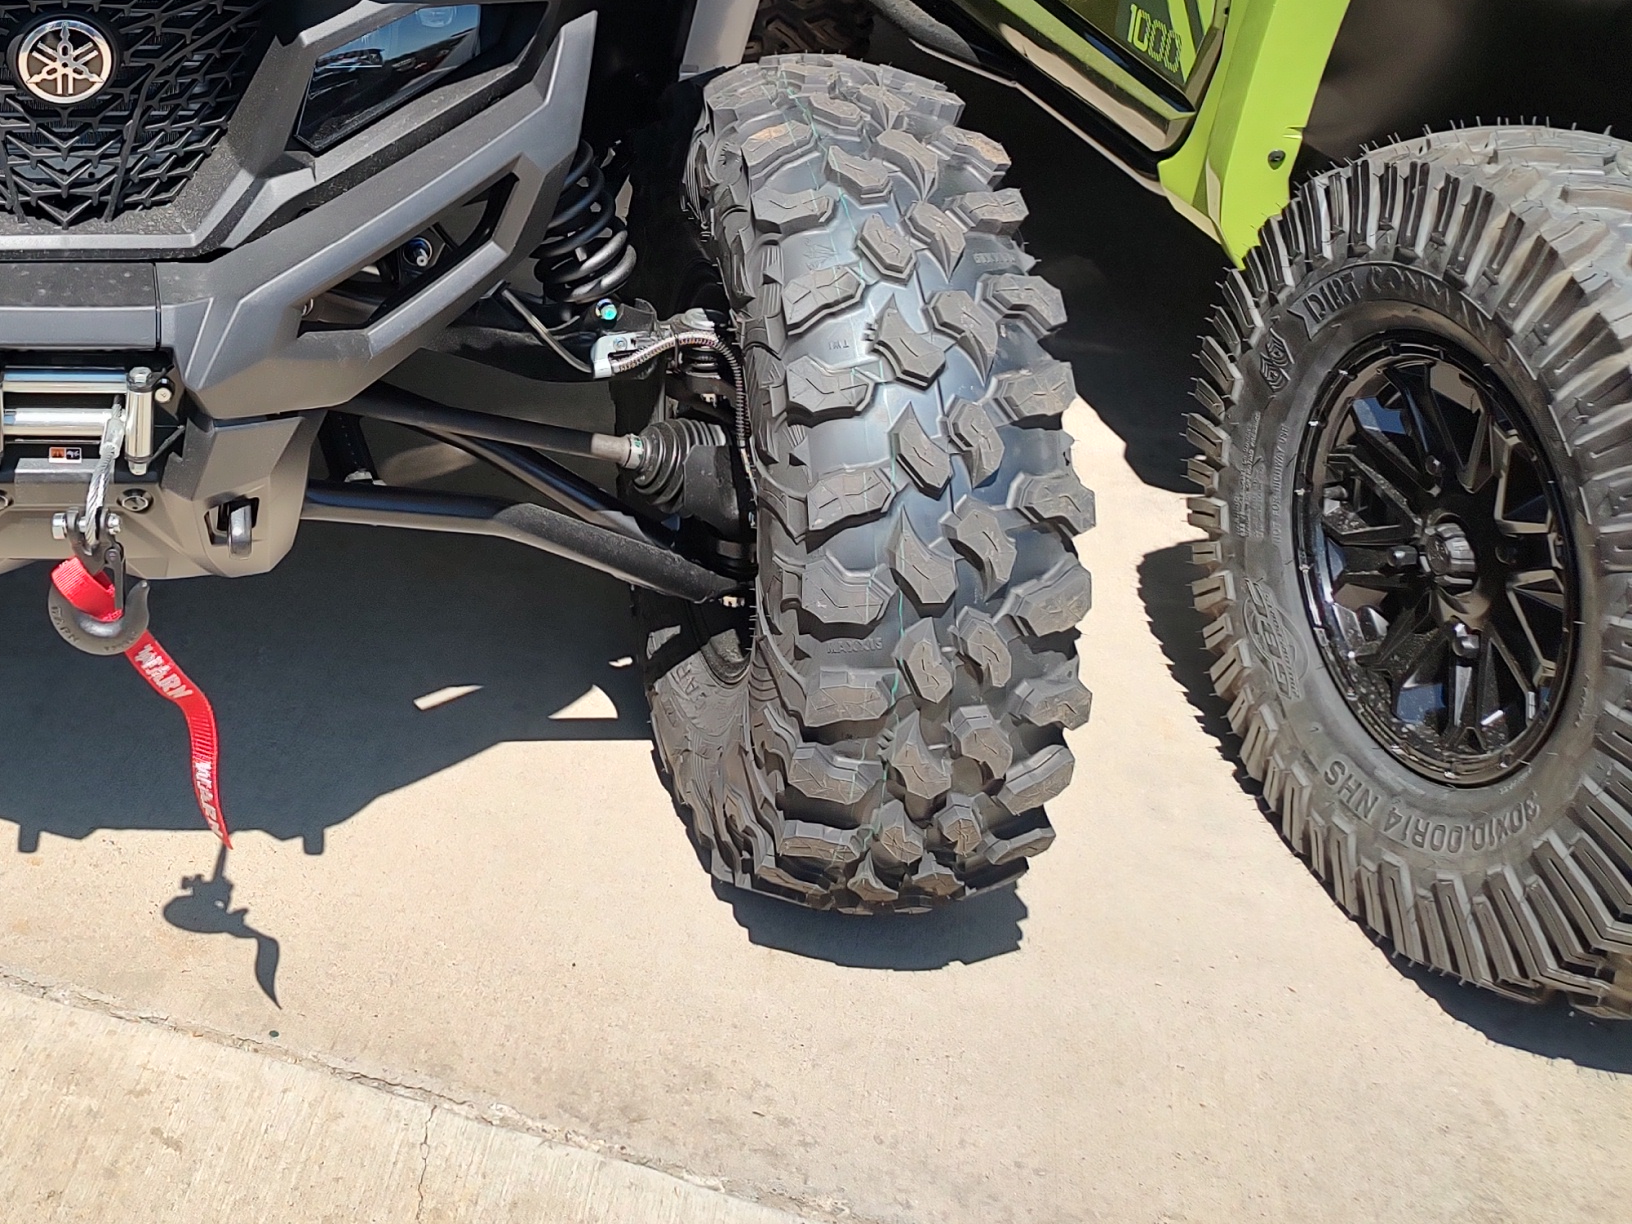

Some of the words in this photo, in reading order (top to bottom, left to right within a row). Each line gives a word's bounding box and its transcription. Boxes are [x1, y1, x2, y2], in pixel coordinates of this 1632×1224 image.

[1127, 4, 1183, 73] 1000
[1302, 271, 1361, 323] DIRT
[134, 643, 193, 699] WARN
[827, 637, 884, 654] MAXXIS
[195, 761, 223, 839] WARN
[1324, 760, 1380, 819] NHS
